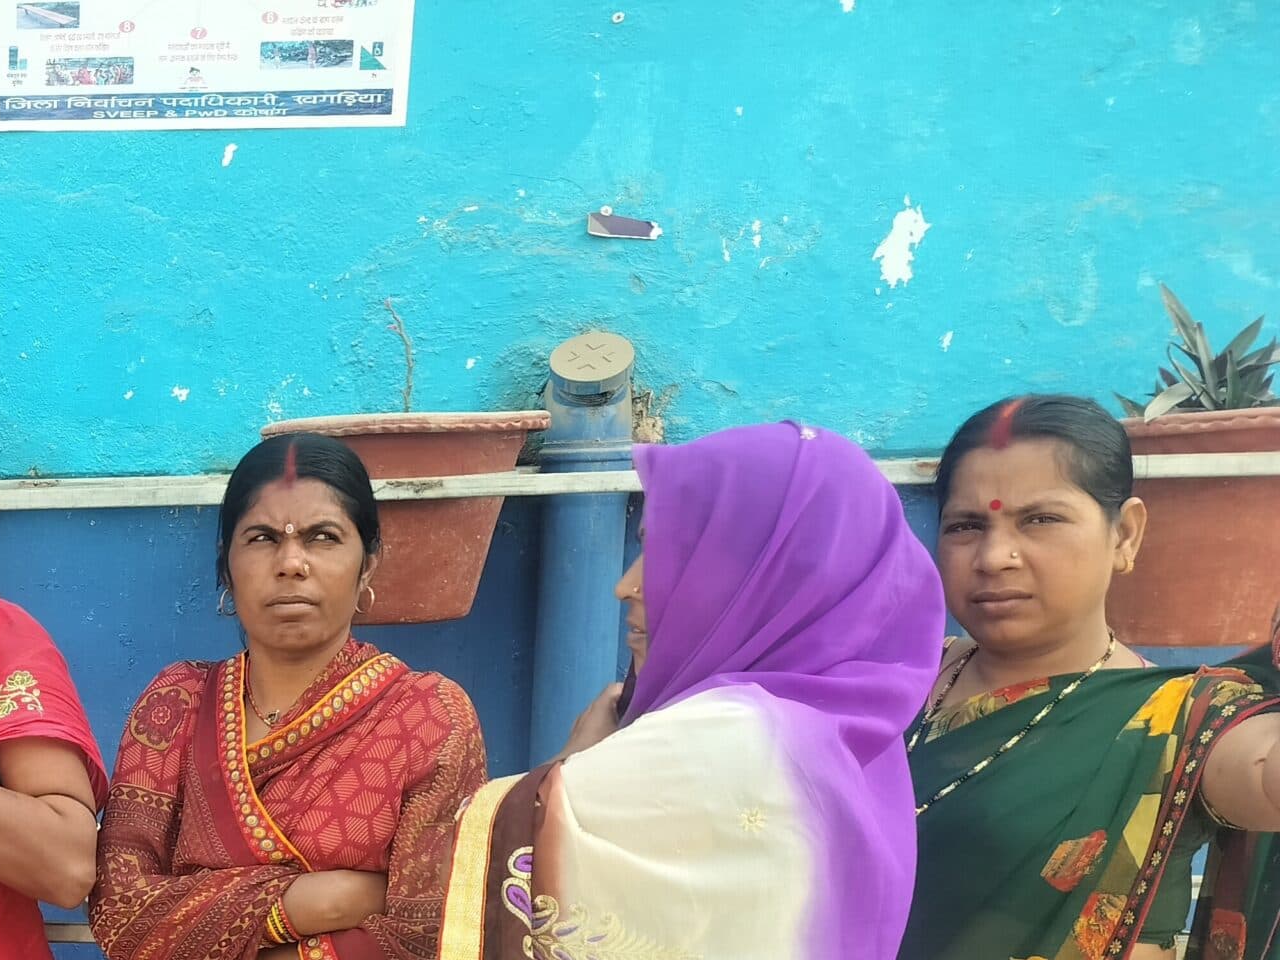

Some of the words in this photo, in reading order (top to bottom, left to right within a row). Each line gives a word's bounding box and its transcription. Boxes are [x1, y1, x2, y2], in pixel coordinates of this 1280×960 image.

[4, 98, 61, 110] जिला
[65, 96, 156, 109] निर्वाचन
[159, 93, 284, 108] पदाधिकारी,
[291, 91, 386, 107] खगड़िया
[92, 110, 158, 119] SVEEP
[166, 109, 178, 118] &
[185, 109, 228, 117] PwD
[233, 107, 288, 116] कोषांग
